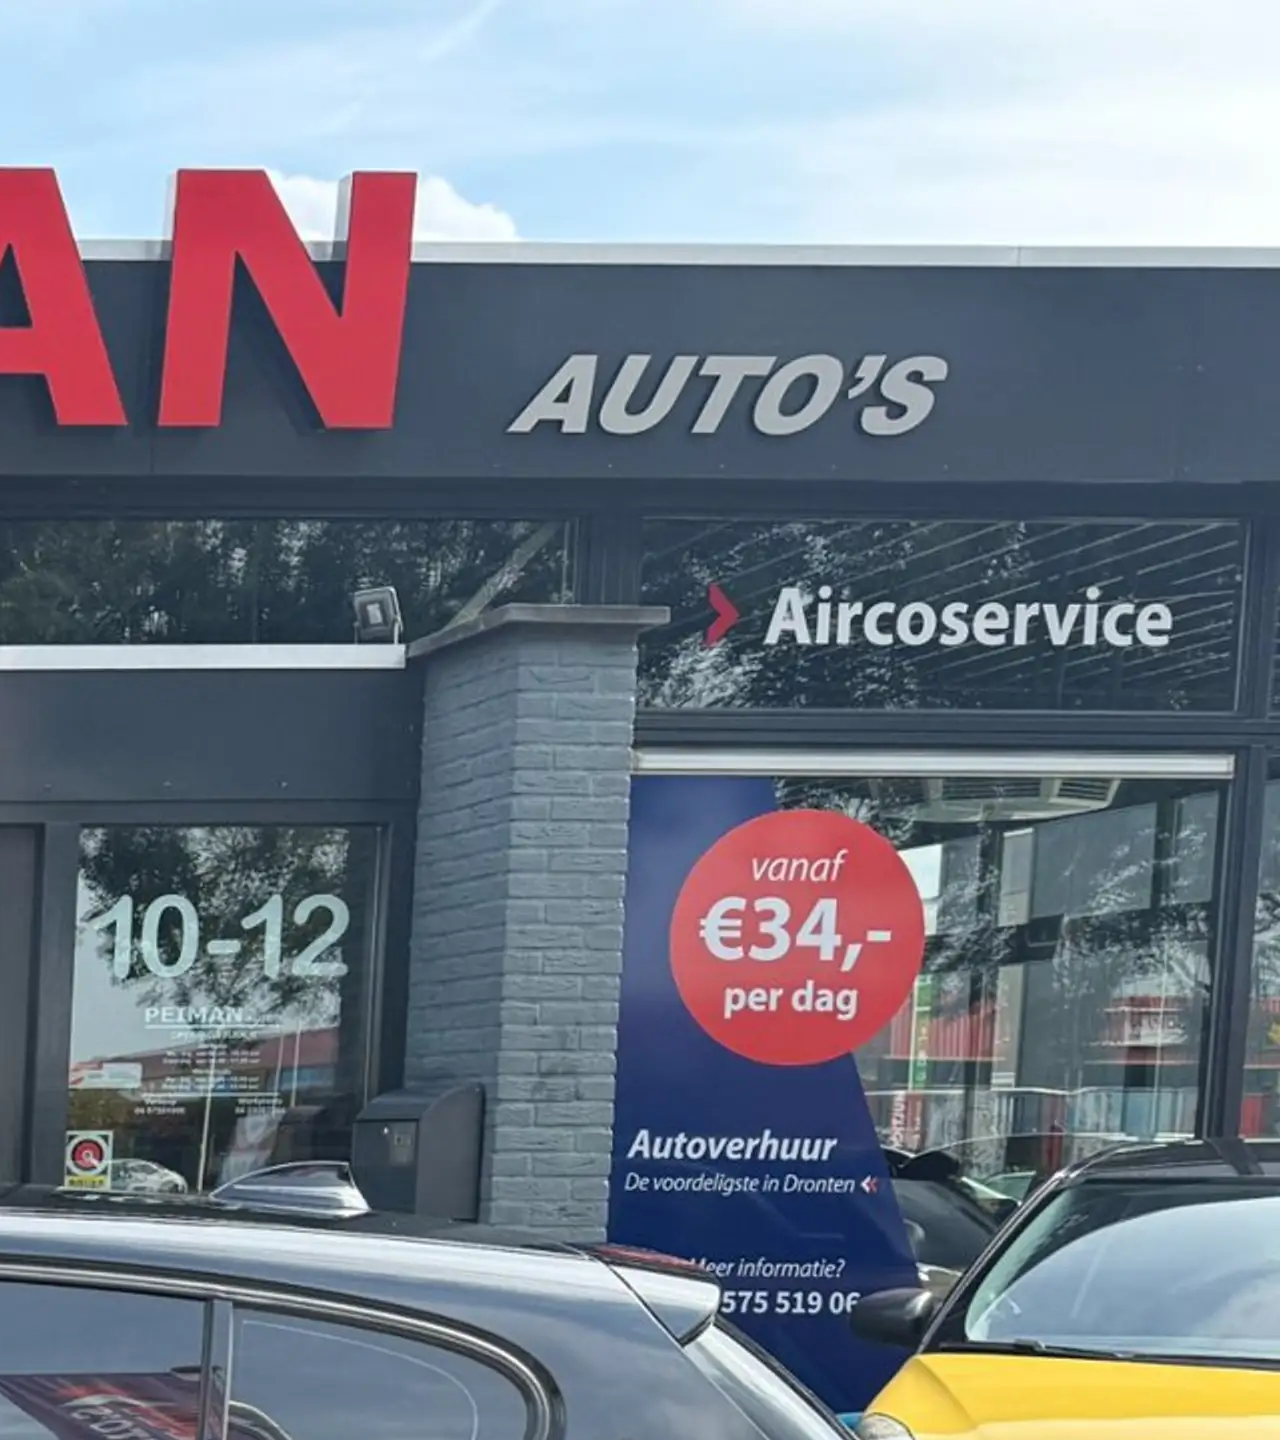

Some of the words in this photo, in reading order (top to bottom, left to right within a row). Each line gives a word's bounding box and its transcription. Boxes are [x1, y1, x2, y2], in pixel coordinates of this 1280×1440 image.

[505, 353, 949, 437] AUTO'S
[762, 584, 1174, 648] Aircoservice
[751, 849, 849, 883] vanaf
[92, 892, 351, 981] 10-12
[698, 895, 892, 973] €34,-
[144, 1005, 243, 1024] PEIMAN
[723, 986, 785, 1020] per
[790, 979, 859, 1022] dag
[626, 1128, 839, 1161] Autoverhuur
[625, 1172, 650, 1191] De
[653, 1172, 759, 1196] voordeligste
[762, 1173, 779, 1191] in
[782, 1173, 855, 1193] Dronten
[737, 1257, 846, 1278] informatie?
[721, 1291, 768, 1313] 575
[775, 1291, 822, 1314] 519
